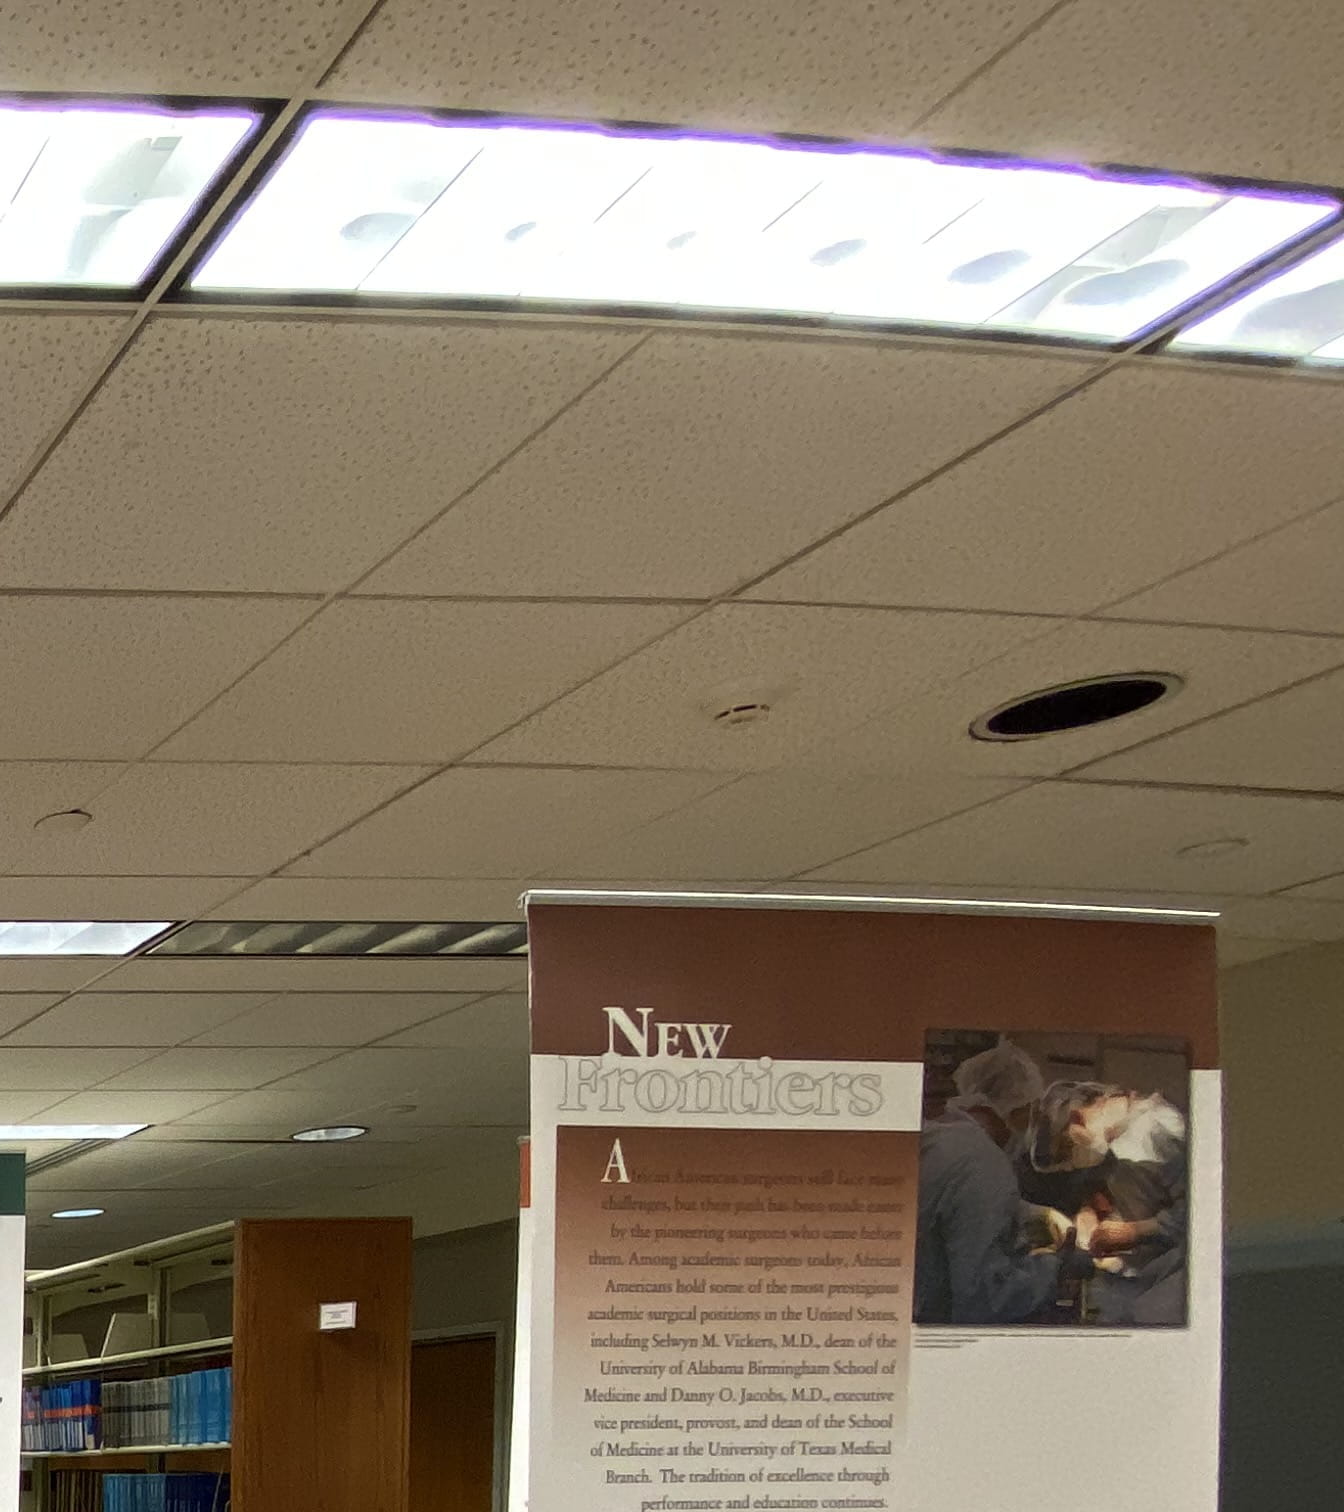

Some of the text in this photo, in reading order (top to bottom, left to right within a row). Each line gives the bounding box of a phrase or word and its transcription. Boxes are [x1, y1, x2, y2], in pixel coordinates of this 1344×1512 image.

[602, 1006, 732, 1060] NEW
[558, 1055, 885, 1117] Frontiers
[725, 1494, 750, 1509] and
[752, 1494, 819, 1509] education
[820, 1494, 888, 1509] continues.
